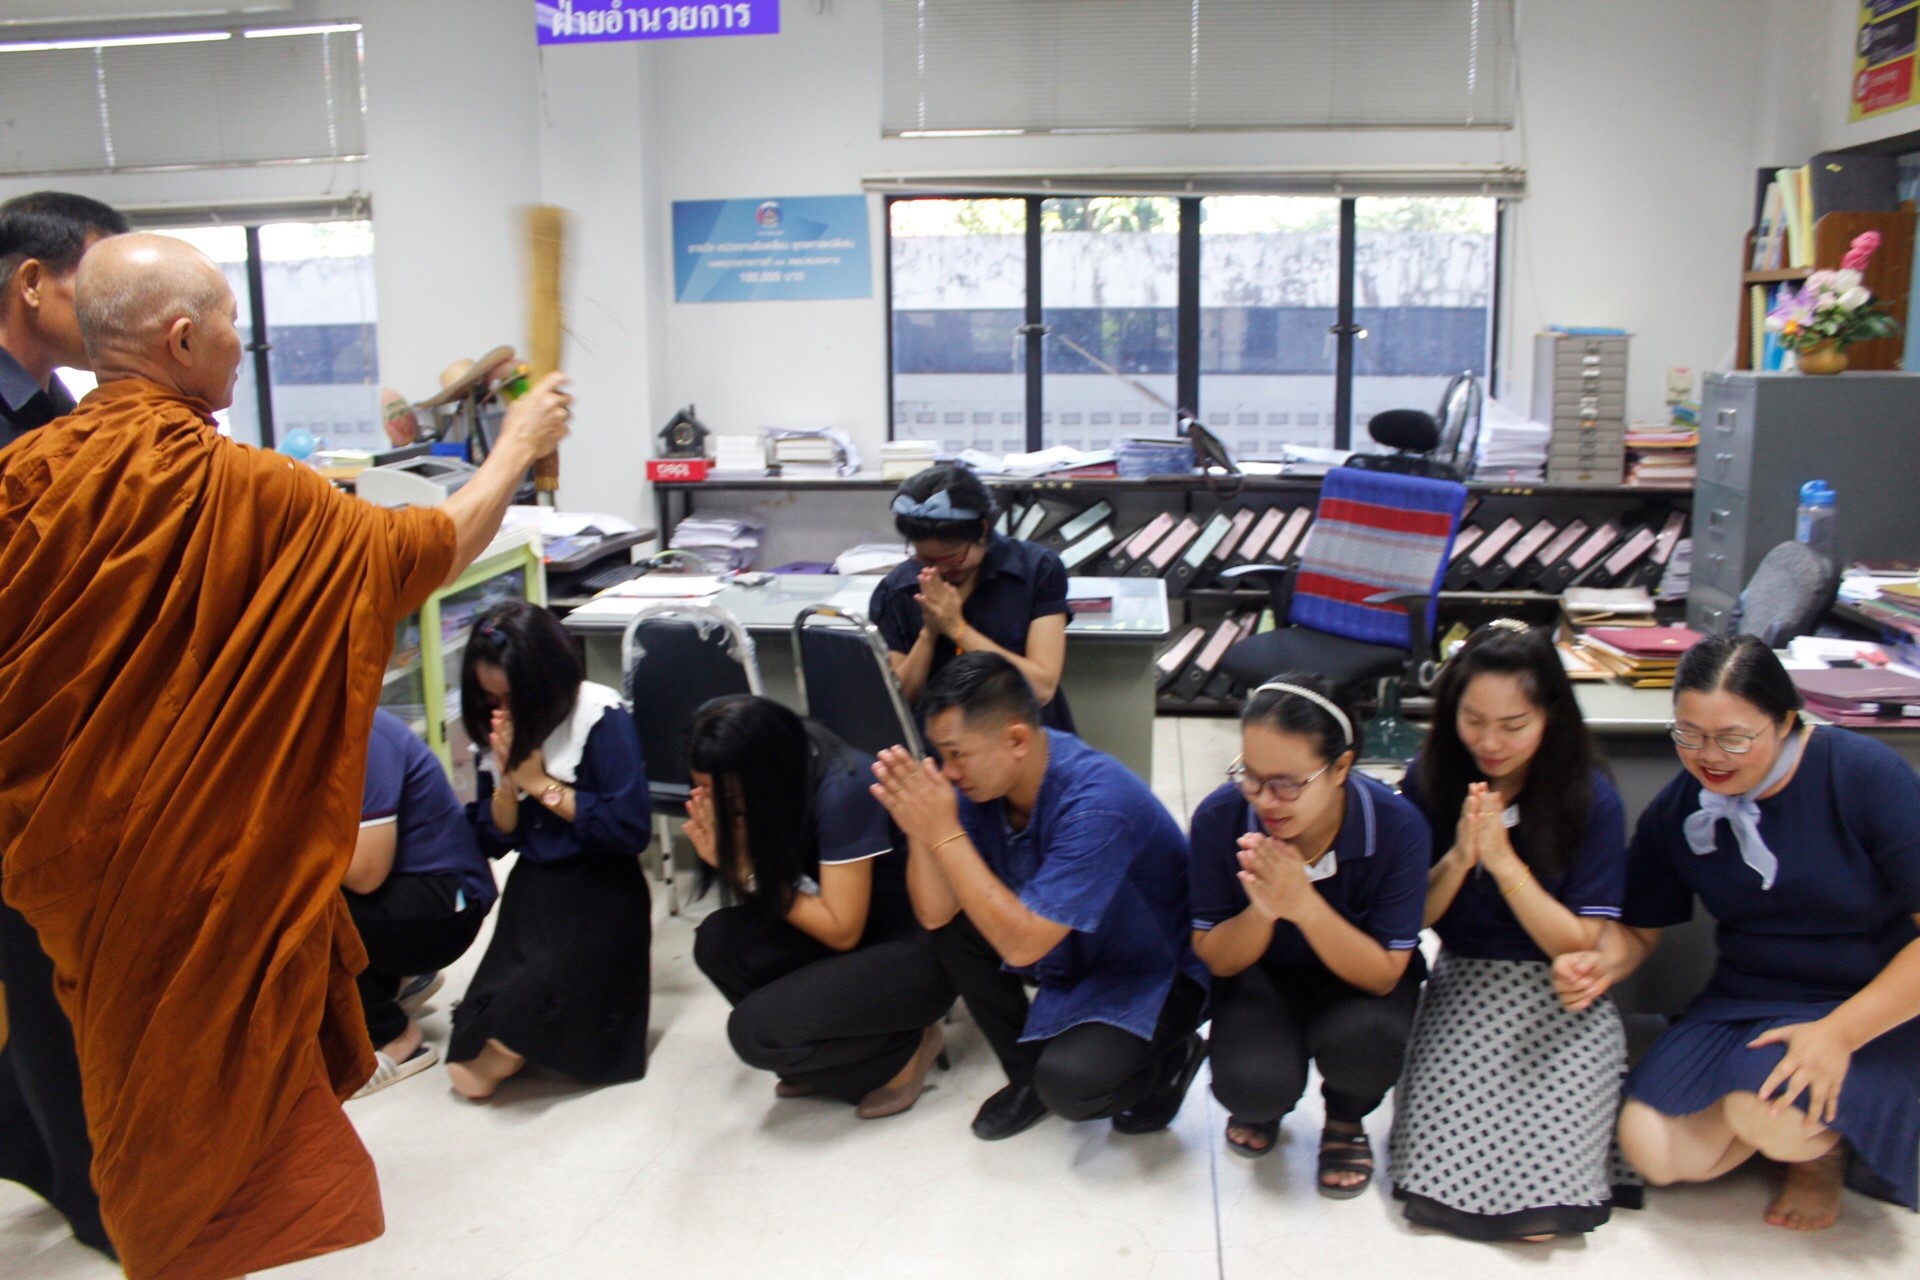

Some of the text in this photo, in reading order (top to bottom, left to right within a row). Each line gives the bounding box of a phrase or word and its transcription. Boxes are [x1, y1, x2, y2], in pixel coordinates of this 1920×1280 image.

[551, 0, 751, 37] ฝ่ายอำนวยการ
